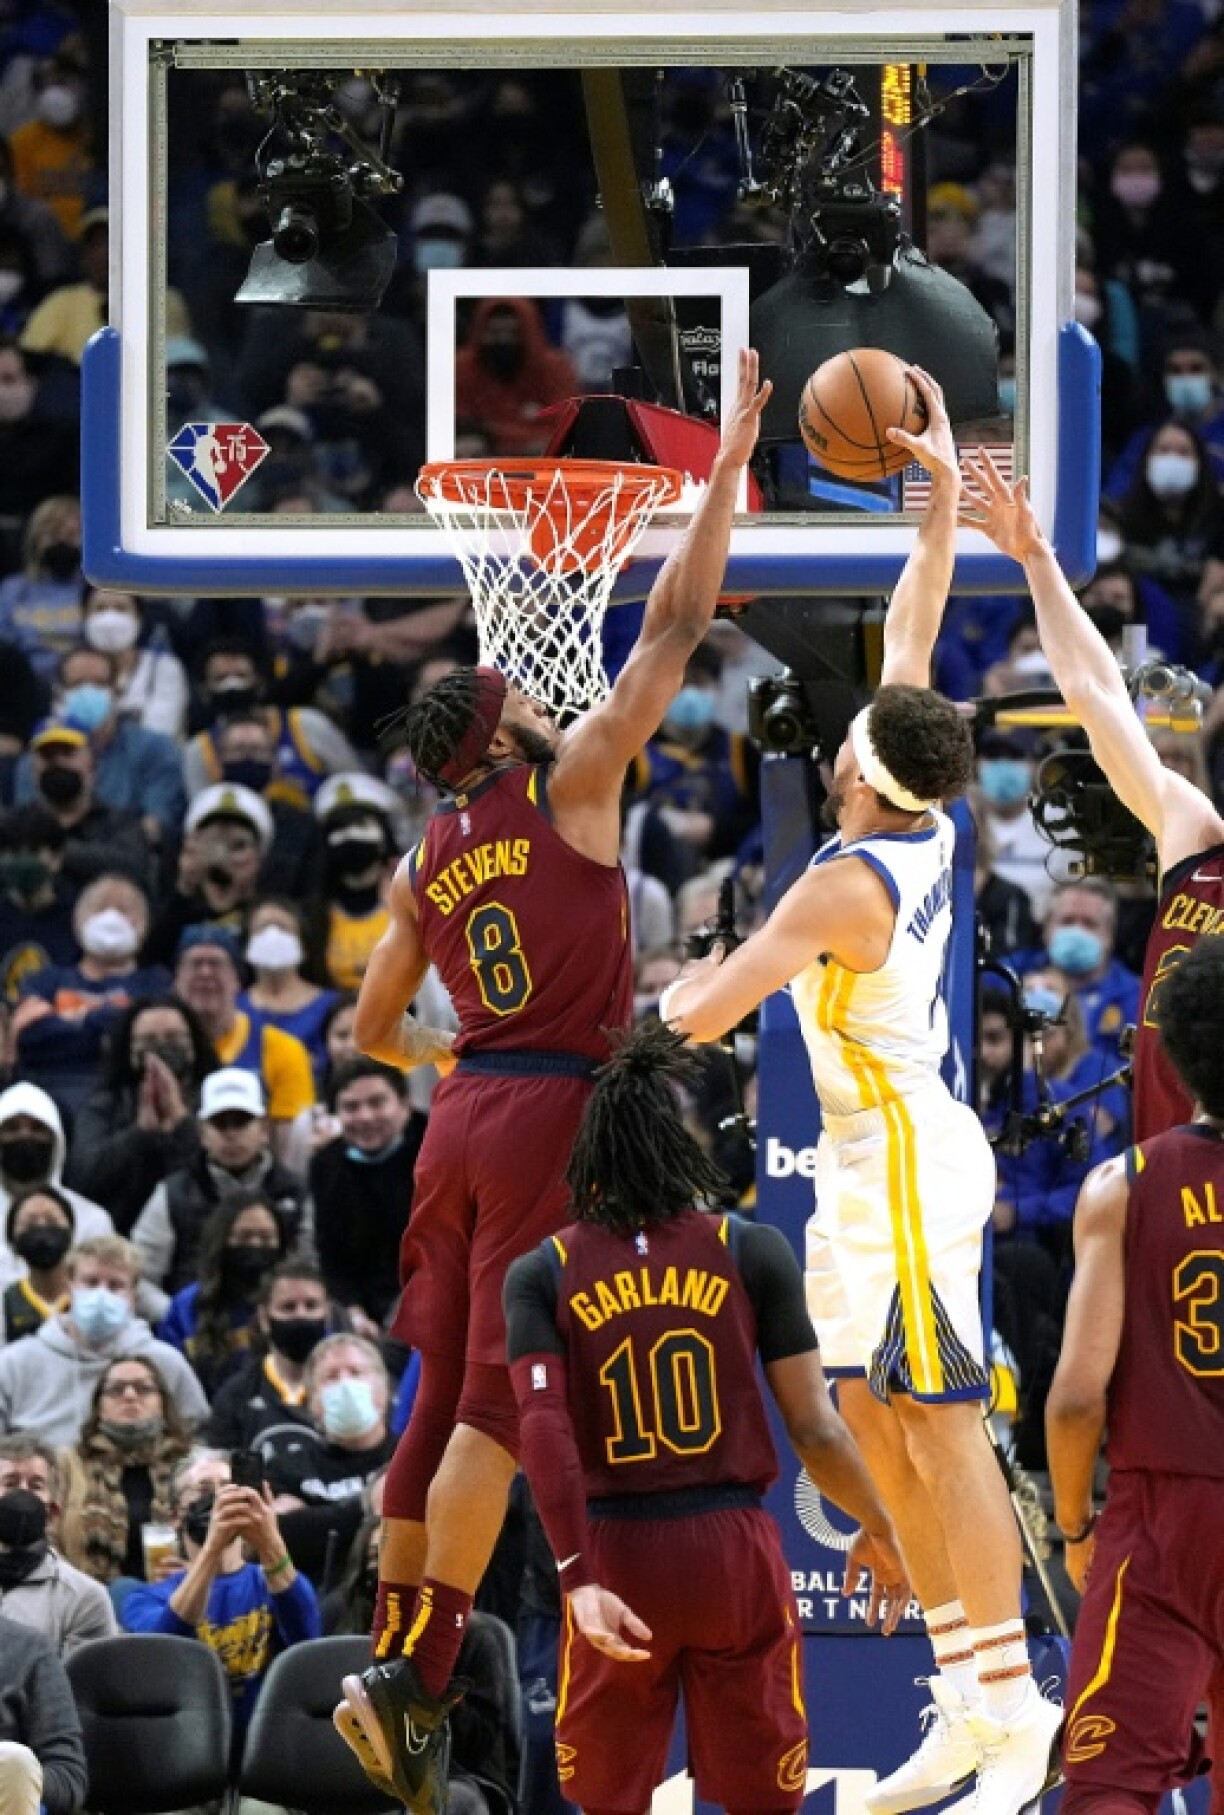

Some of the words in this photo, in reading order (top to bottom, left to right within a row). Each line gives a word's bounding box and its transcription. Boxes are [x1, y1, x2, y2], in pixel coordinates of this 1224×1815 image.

[226, 435, 246, 461] 75
[425, 839, 530, 915] STEVENS
[1162, 893, 1224, 936] CLEV
[465, 902, 532, 1016] 8
[766, 1137, 818, 1178] be
[1180, 1182, 1224, 1228] AL
[569, 1266, 730, 1331] GARLAND
[1173, 1250, 1224, 1377] 3
[599, 1328, 722, 1463] 10
